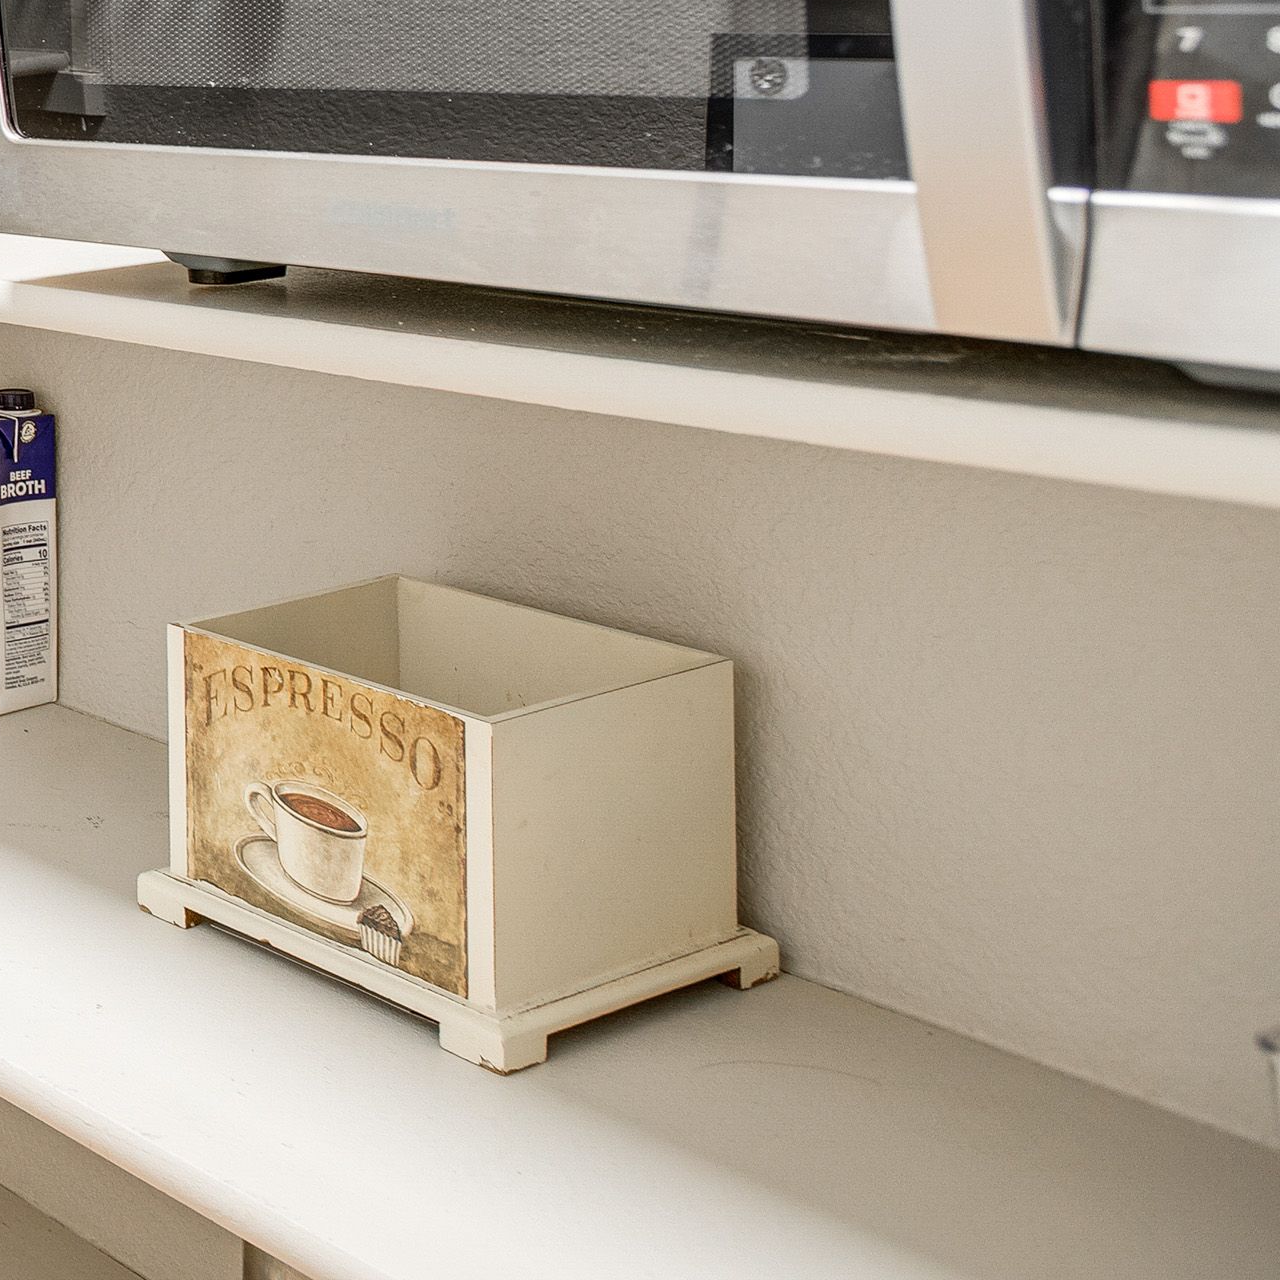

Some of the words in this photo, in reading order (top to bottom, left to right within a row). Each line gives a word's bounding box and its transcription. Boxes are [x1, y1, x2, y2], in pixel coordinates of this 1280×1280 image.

[9, 469, 32, 482] BEEF
[0, 479, 47, 500] BROTH
[2, 526, 27, 537] Nutrition
[27, 524, 47, 533] Facts
[3, 556, 24, 565] Calories
[38, 549, 48, 559] 10
[202, 663, 442, 791] ESPRESSO
